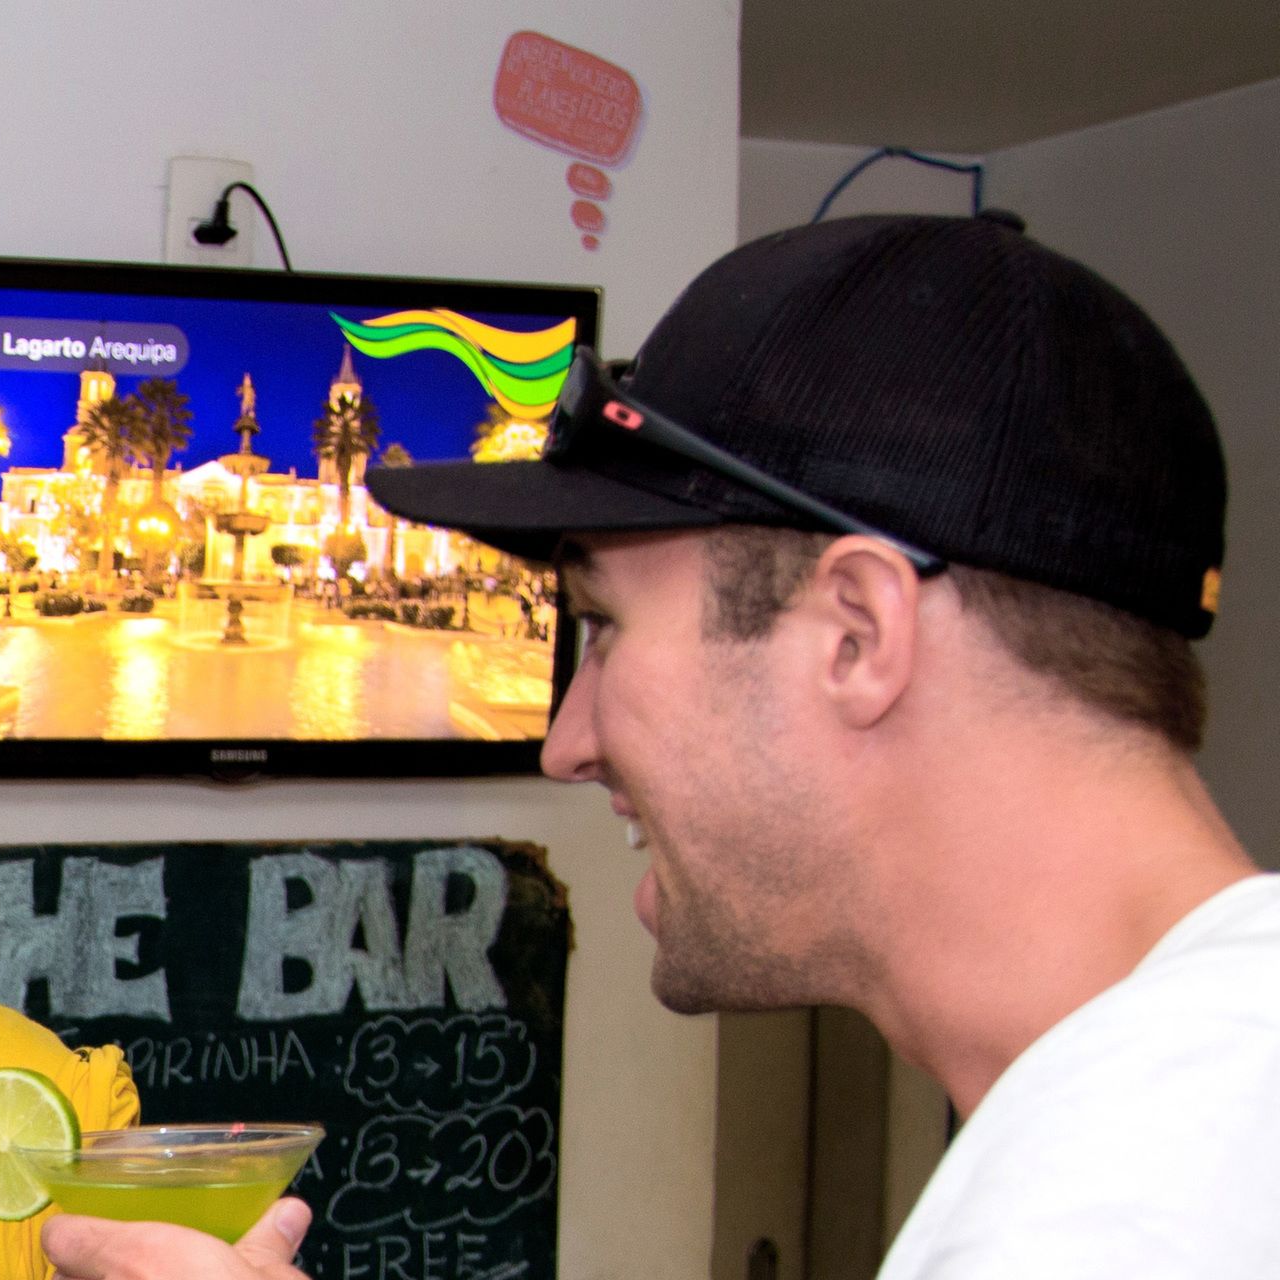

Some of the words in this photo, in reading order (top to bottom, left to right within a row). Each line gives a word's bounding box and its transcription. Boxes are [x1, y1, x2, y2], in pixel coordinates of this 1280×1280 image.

[3, 332, 86, 362] Lagarto
[89, 336, 177, 365] Arequipa
[240, 848, 508, 1022] BAR
[368, 1034, 399, 1088] 3
[451, 1030, 507, 1088] 15
[445, 1130, 534, 1192] 20
